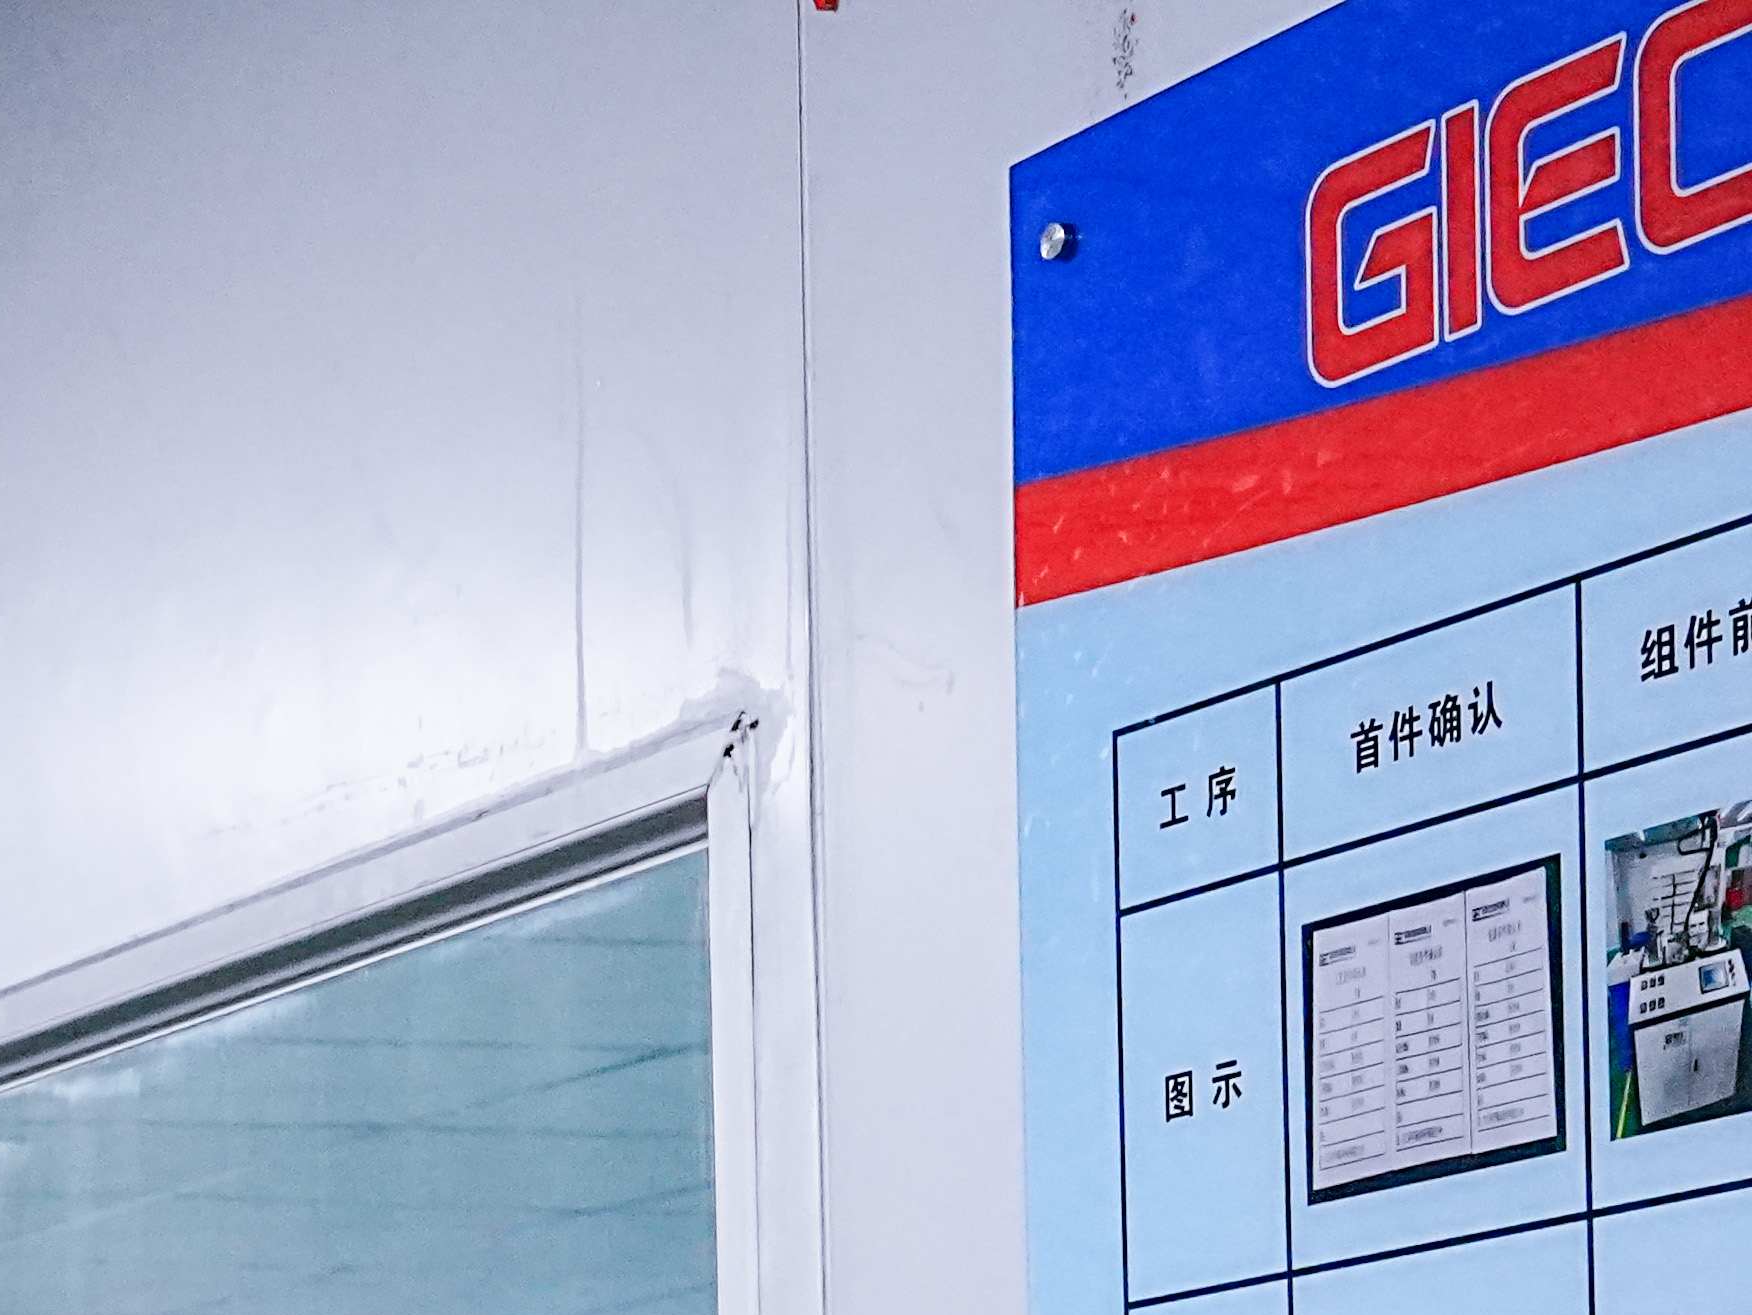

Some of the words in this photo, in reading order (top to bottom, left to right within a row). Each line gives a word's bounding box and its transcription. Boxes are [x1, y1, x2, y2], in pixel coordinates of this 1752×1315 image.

[1350, 680, 1503, 774] 首件确认
[1159, 765, 1237, 830] 工序
[1164, 1059, 1242, 1123] 图示
